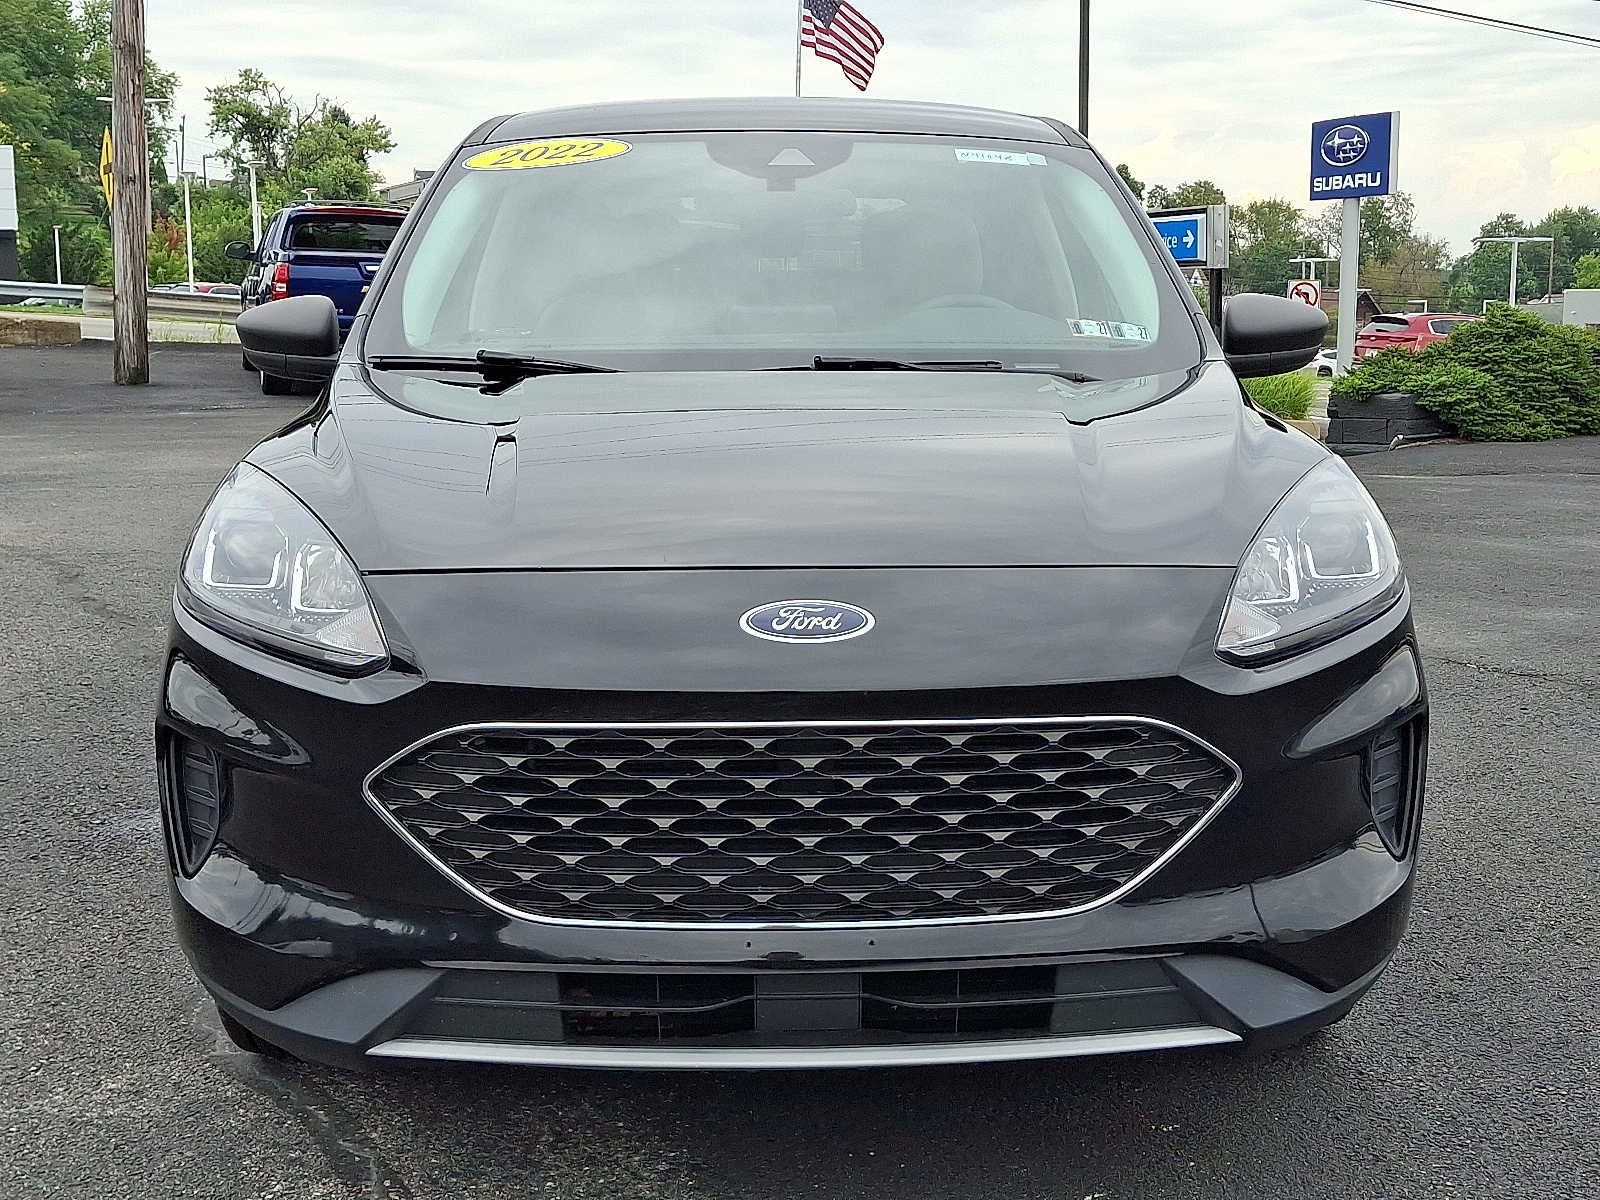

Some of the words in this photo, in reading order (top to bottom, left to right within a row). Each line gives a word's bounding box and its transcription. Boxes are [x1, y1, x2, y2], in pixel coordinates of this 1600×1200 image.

[490, 142, 604, 166] 2022
[1313, 172, 1381, 192] SUBARU
[771, 606, 843, 631] Ford
